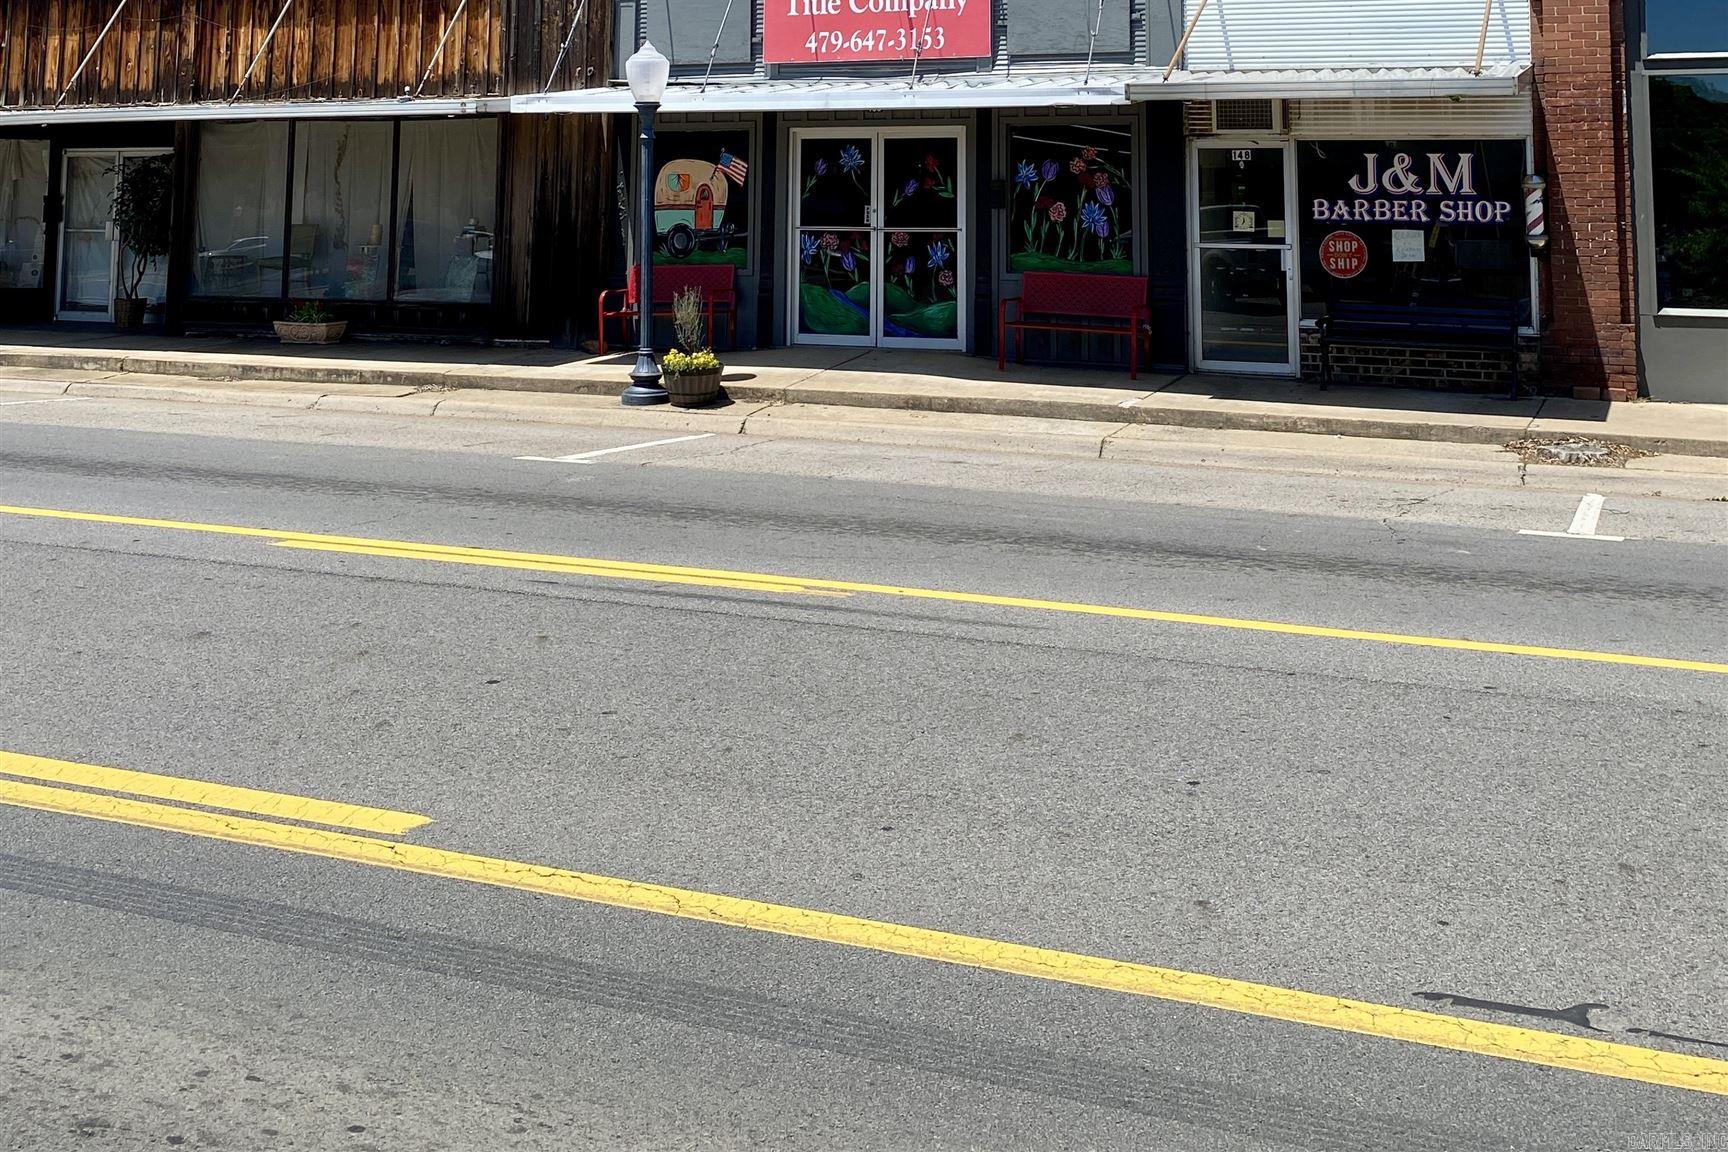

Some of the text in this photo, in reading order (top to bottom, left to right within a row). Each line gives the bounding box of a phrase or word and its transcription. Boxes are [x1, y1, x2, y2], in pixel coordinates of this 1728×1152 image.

[804, 26, 946, 54] 479-647-3153
[1232, 150, 1251, 160] 148
[1347, 152, 1477, 195] J&M
[1312, 199, 1512, 223] BARBER SHOP
[1328, 240, 1358, 253] SHOP
[1329, 257, 1358, 270] SHIP
